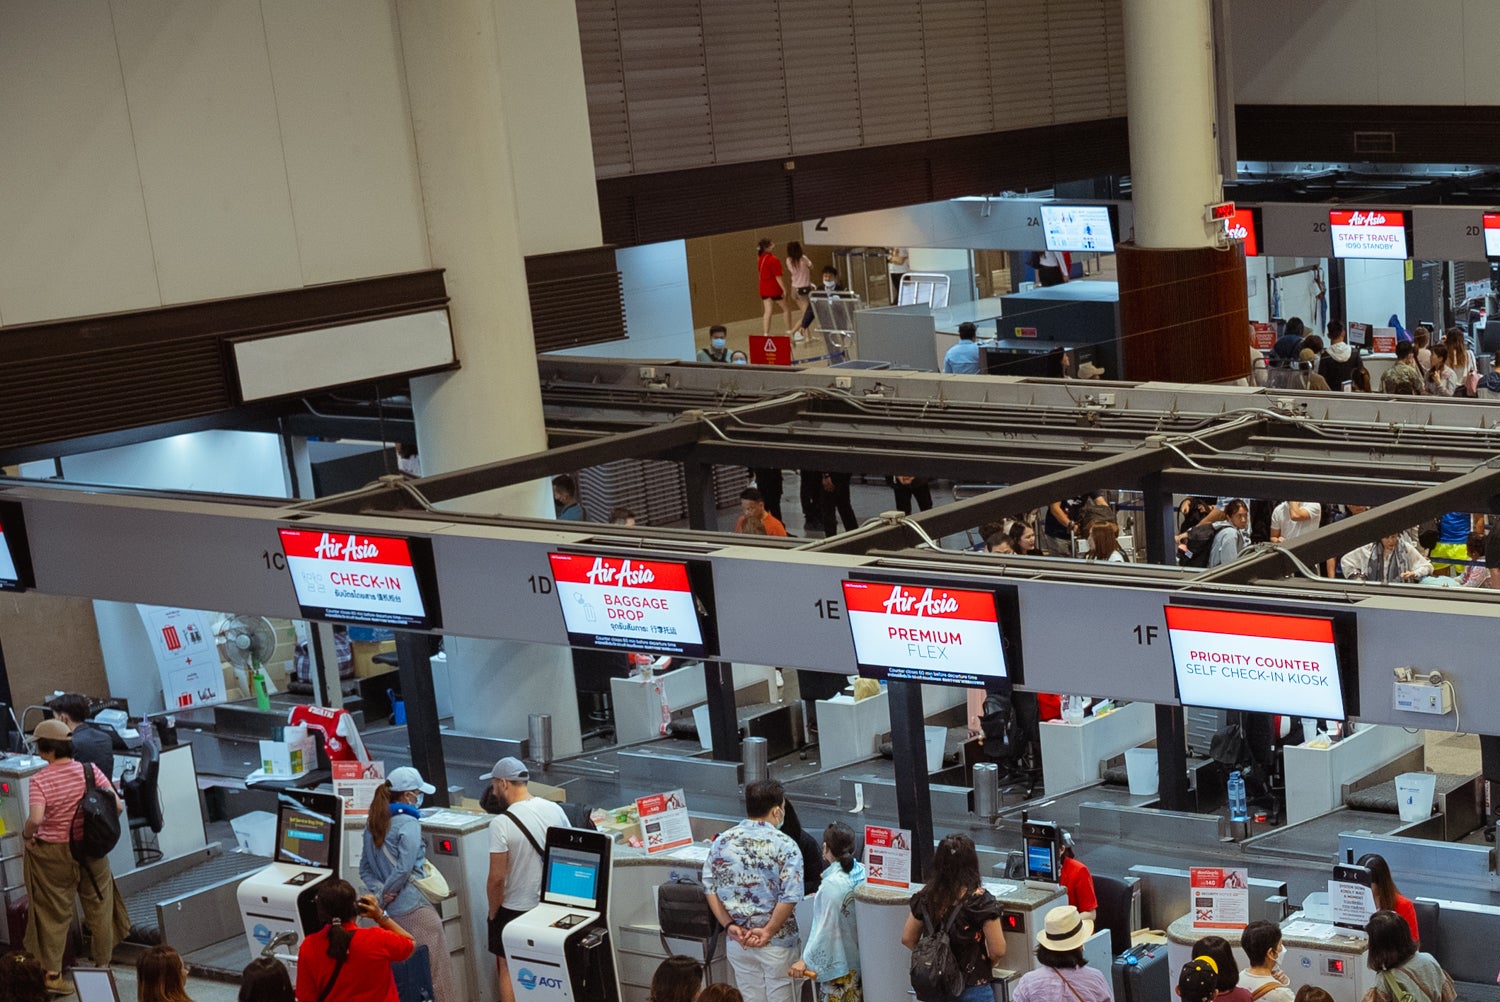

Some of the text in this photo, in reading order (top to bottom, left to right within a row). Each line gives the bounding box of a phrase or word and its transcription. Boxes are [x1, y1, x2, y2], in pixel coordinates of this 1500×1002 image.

[1027, 217, 1039, 226] 2A
[1313, 223, 1326, 233] 2C
[1338, 233, 1399, 242] STAFF TRAVEL
[1466, 226, 1479, 236] 2D
[262, 551, 285, 571] 1C
[330, 571, 402, 591] CHECK-IN
[528, 575, 552, 595] 1D
[604, 594, 669, 610] BAGGAGE
[814, 598, 840, 620] 1E
[607, 608, 644, 621] DROP
[888, 627, 962, 645] PREMIUM
[1133, 625, 1158, 645] 1F
[907, 643, 949, 660] FLEX
[1190, 650, 1320, 672] PRIORITY COUNTER
[1186, 663, 1329, 686] SELF CHECK-IN KIOSK
[538, 976, 563, 989] AOT
